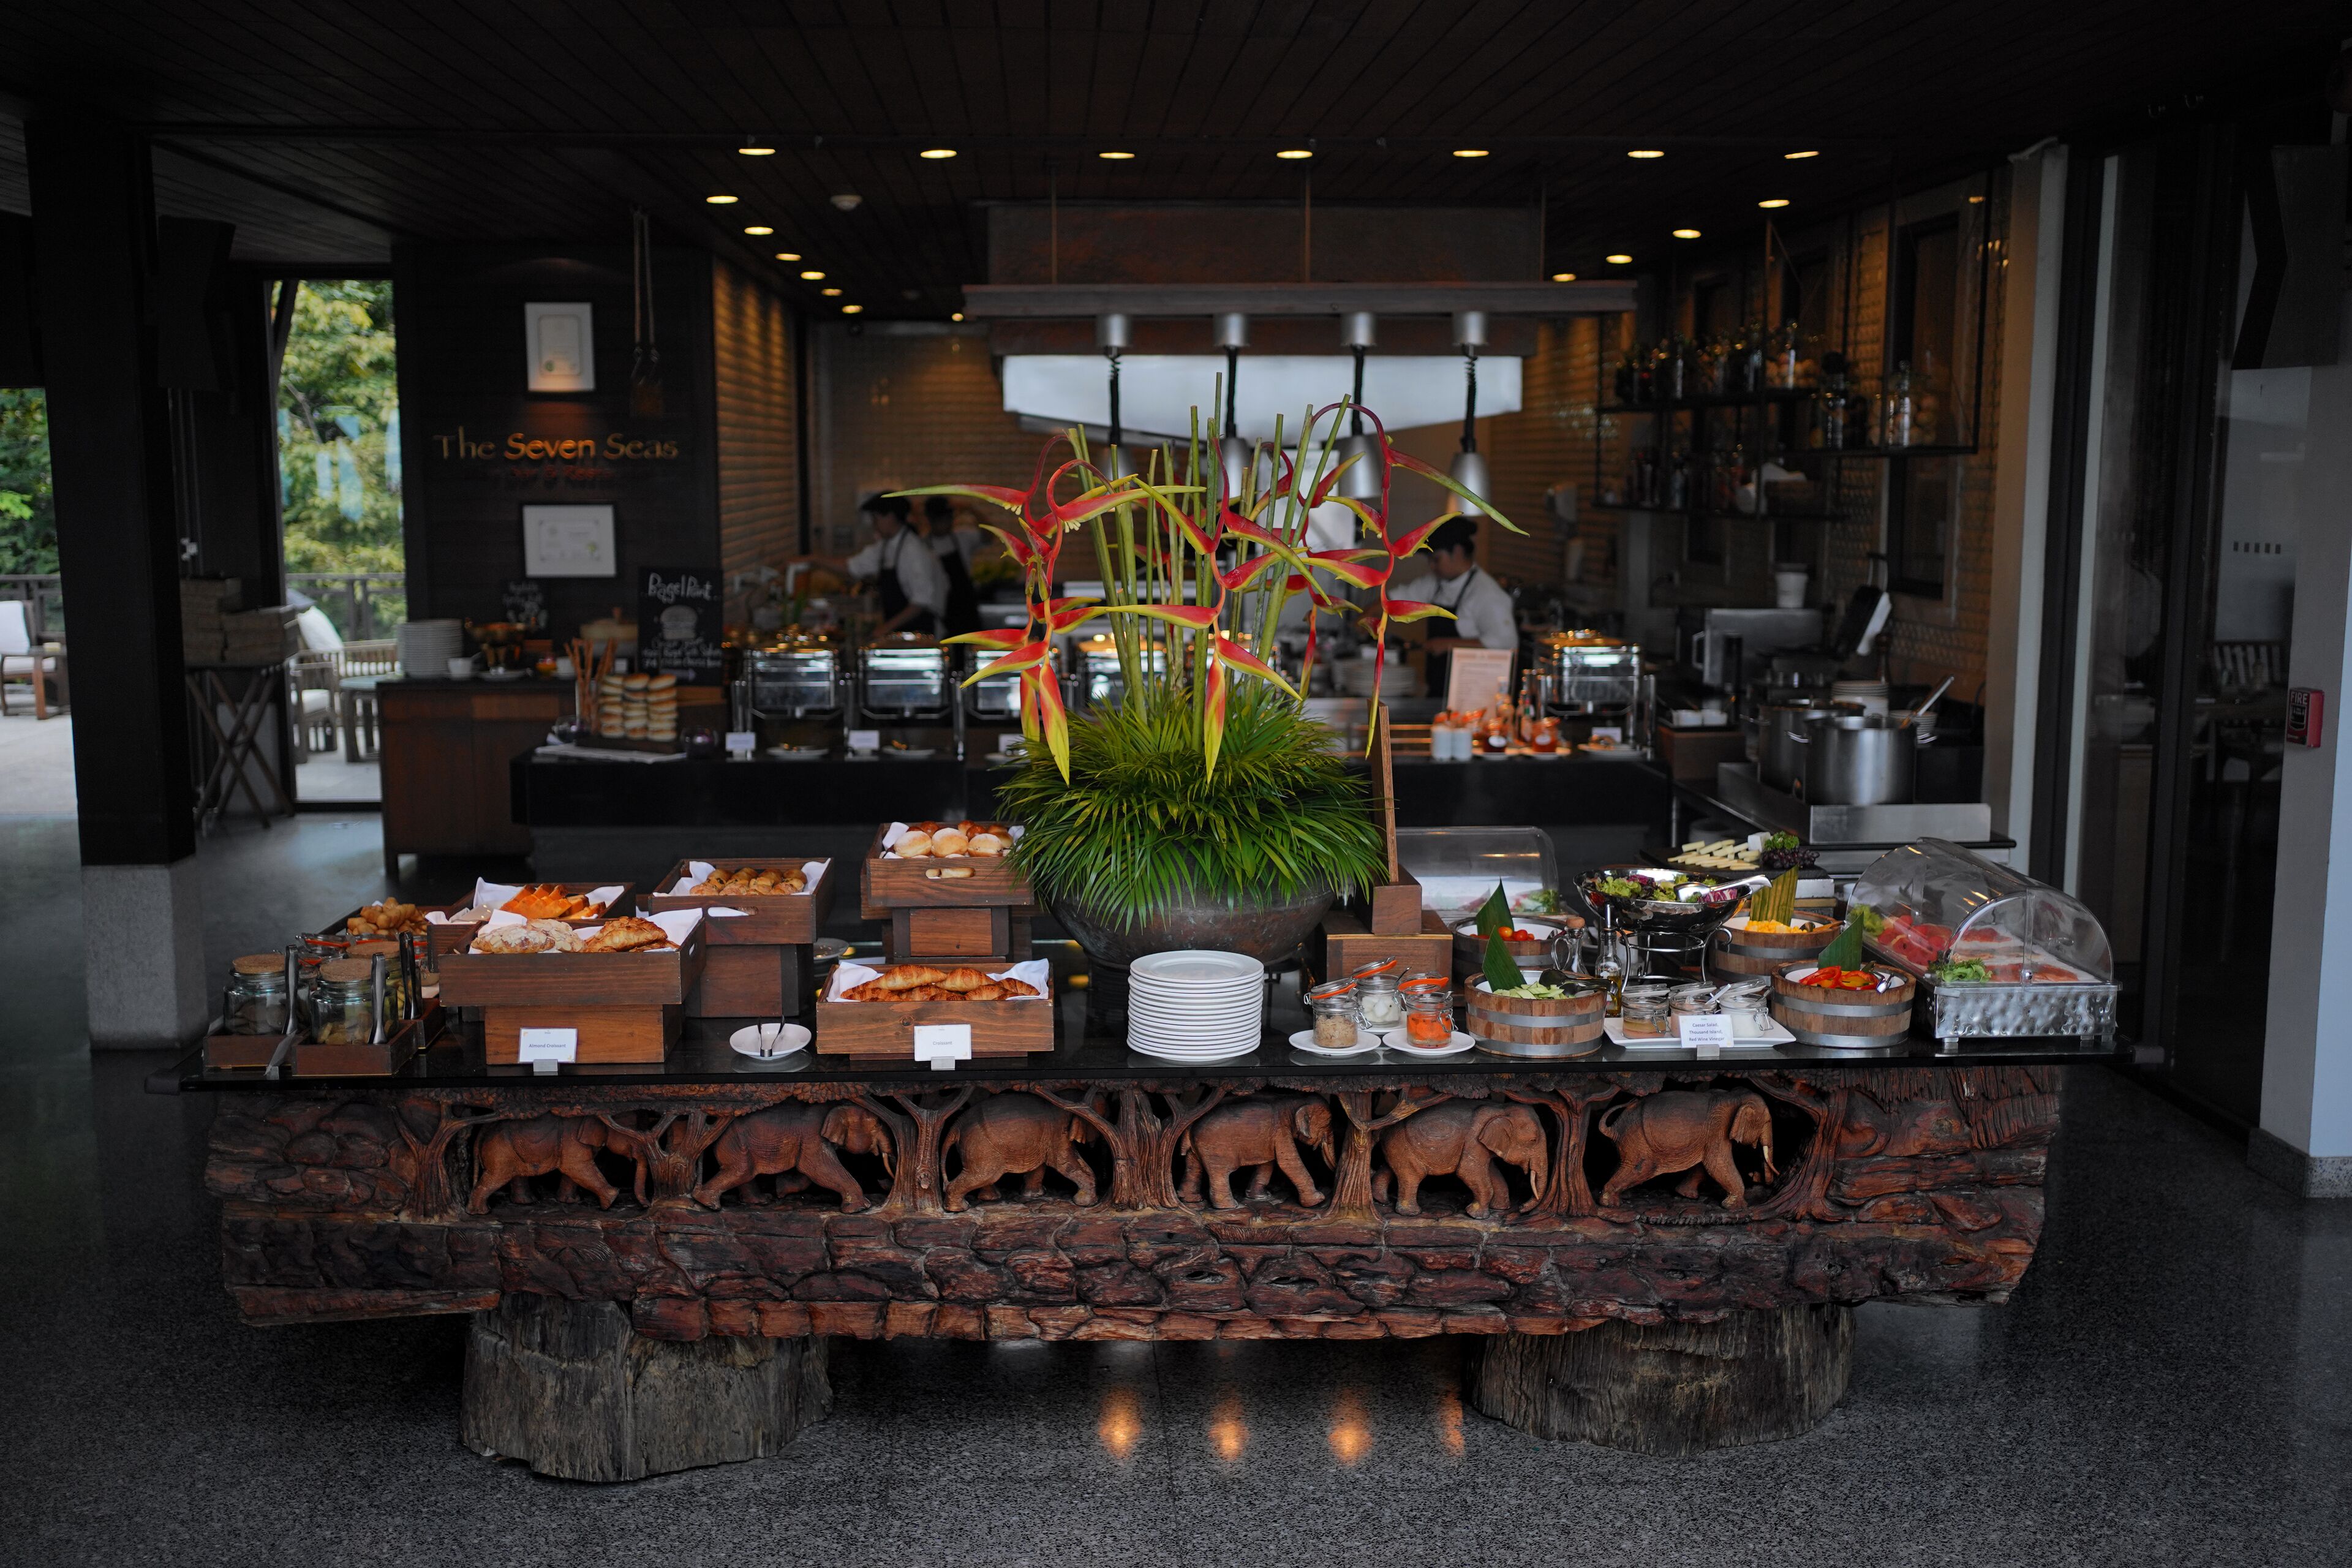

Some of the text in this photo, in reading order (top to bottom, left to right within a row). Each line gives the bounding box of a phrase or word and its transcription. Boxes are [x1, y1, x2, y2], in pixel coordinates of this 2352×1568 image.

[433, 425, 679, 461] The Seven Seas
[2290, 690, 2308, 705] FIRE
